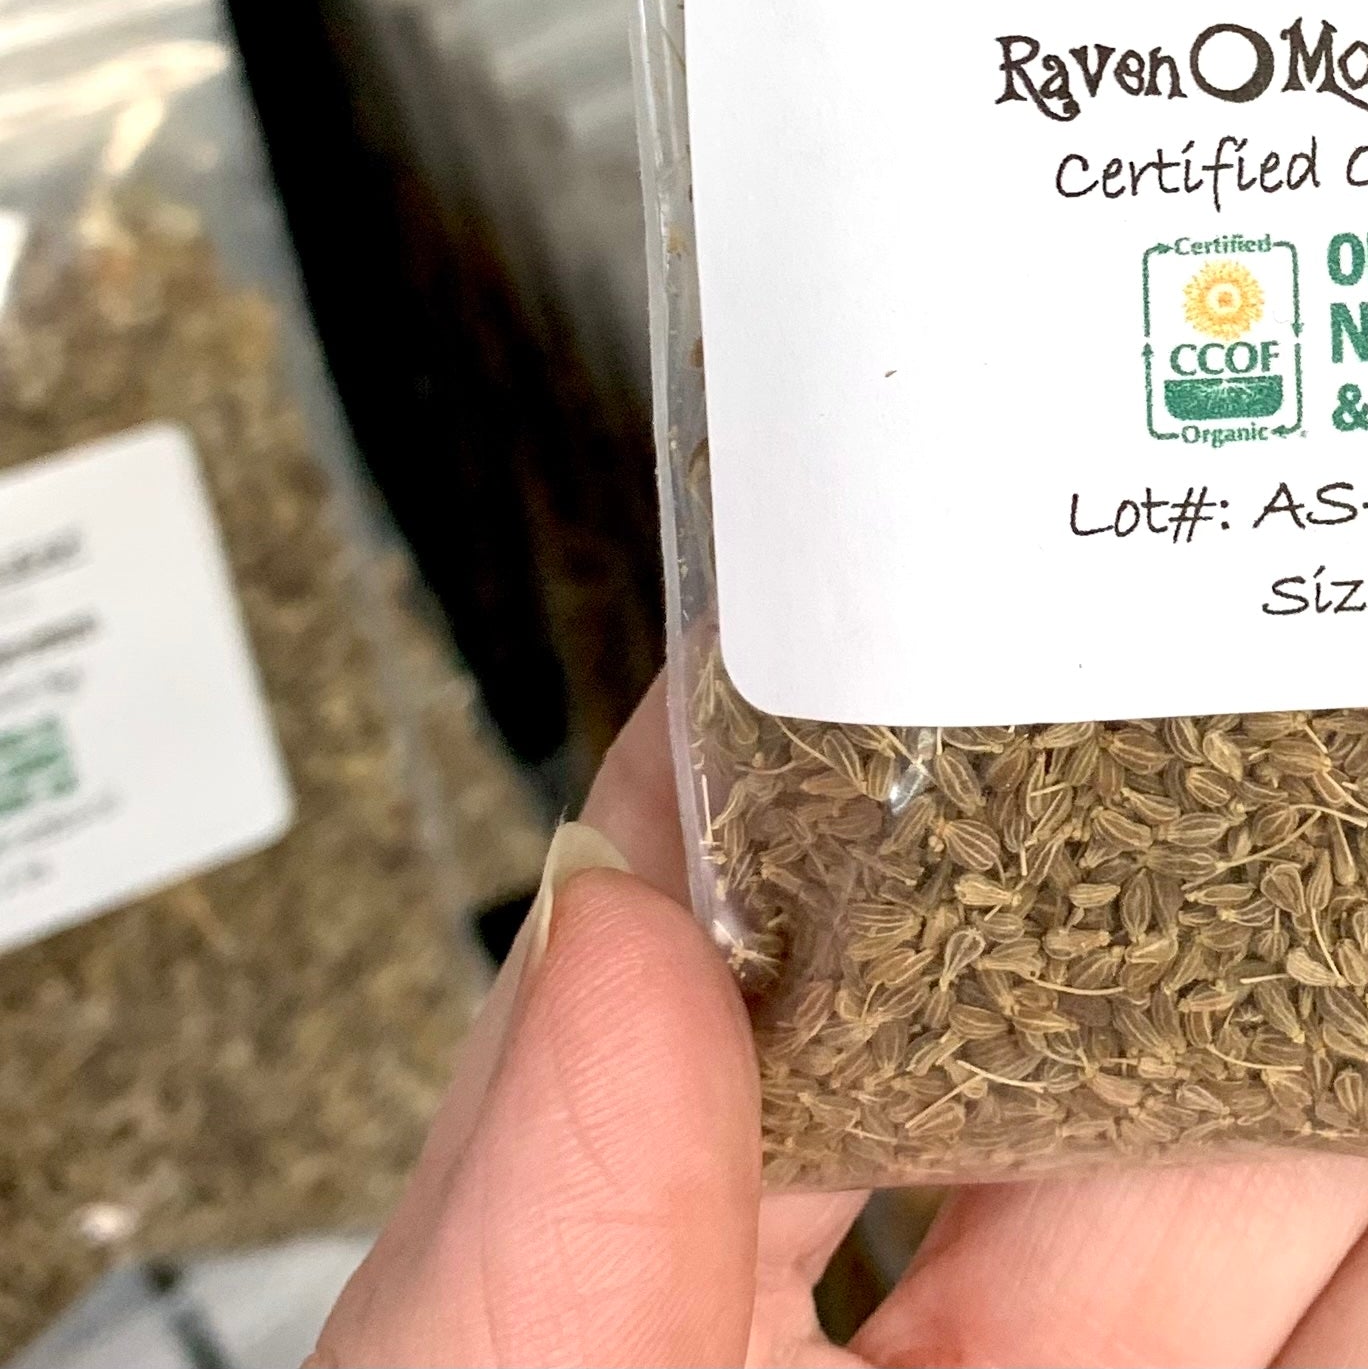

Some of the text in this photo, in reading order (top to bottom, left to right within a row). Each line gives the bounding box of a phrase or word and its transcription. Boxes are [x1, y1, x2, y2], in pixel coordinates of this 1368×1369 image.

[1055, 135, 1321, 213] Certified
[1174, 233, 1272, 256] Certified
[1169, 340, 1283, 376] CCOF
[1181, 425, 1269, 449] Organic
[1069, 486, 1230, 544] Lot#:
